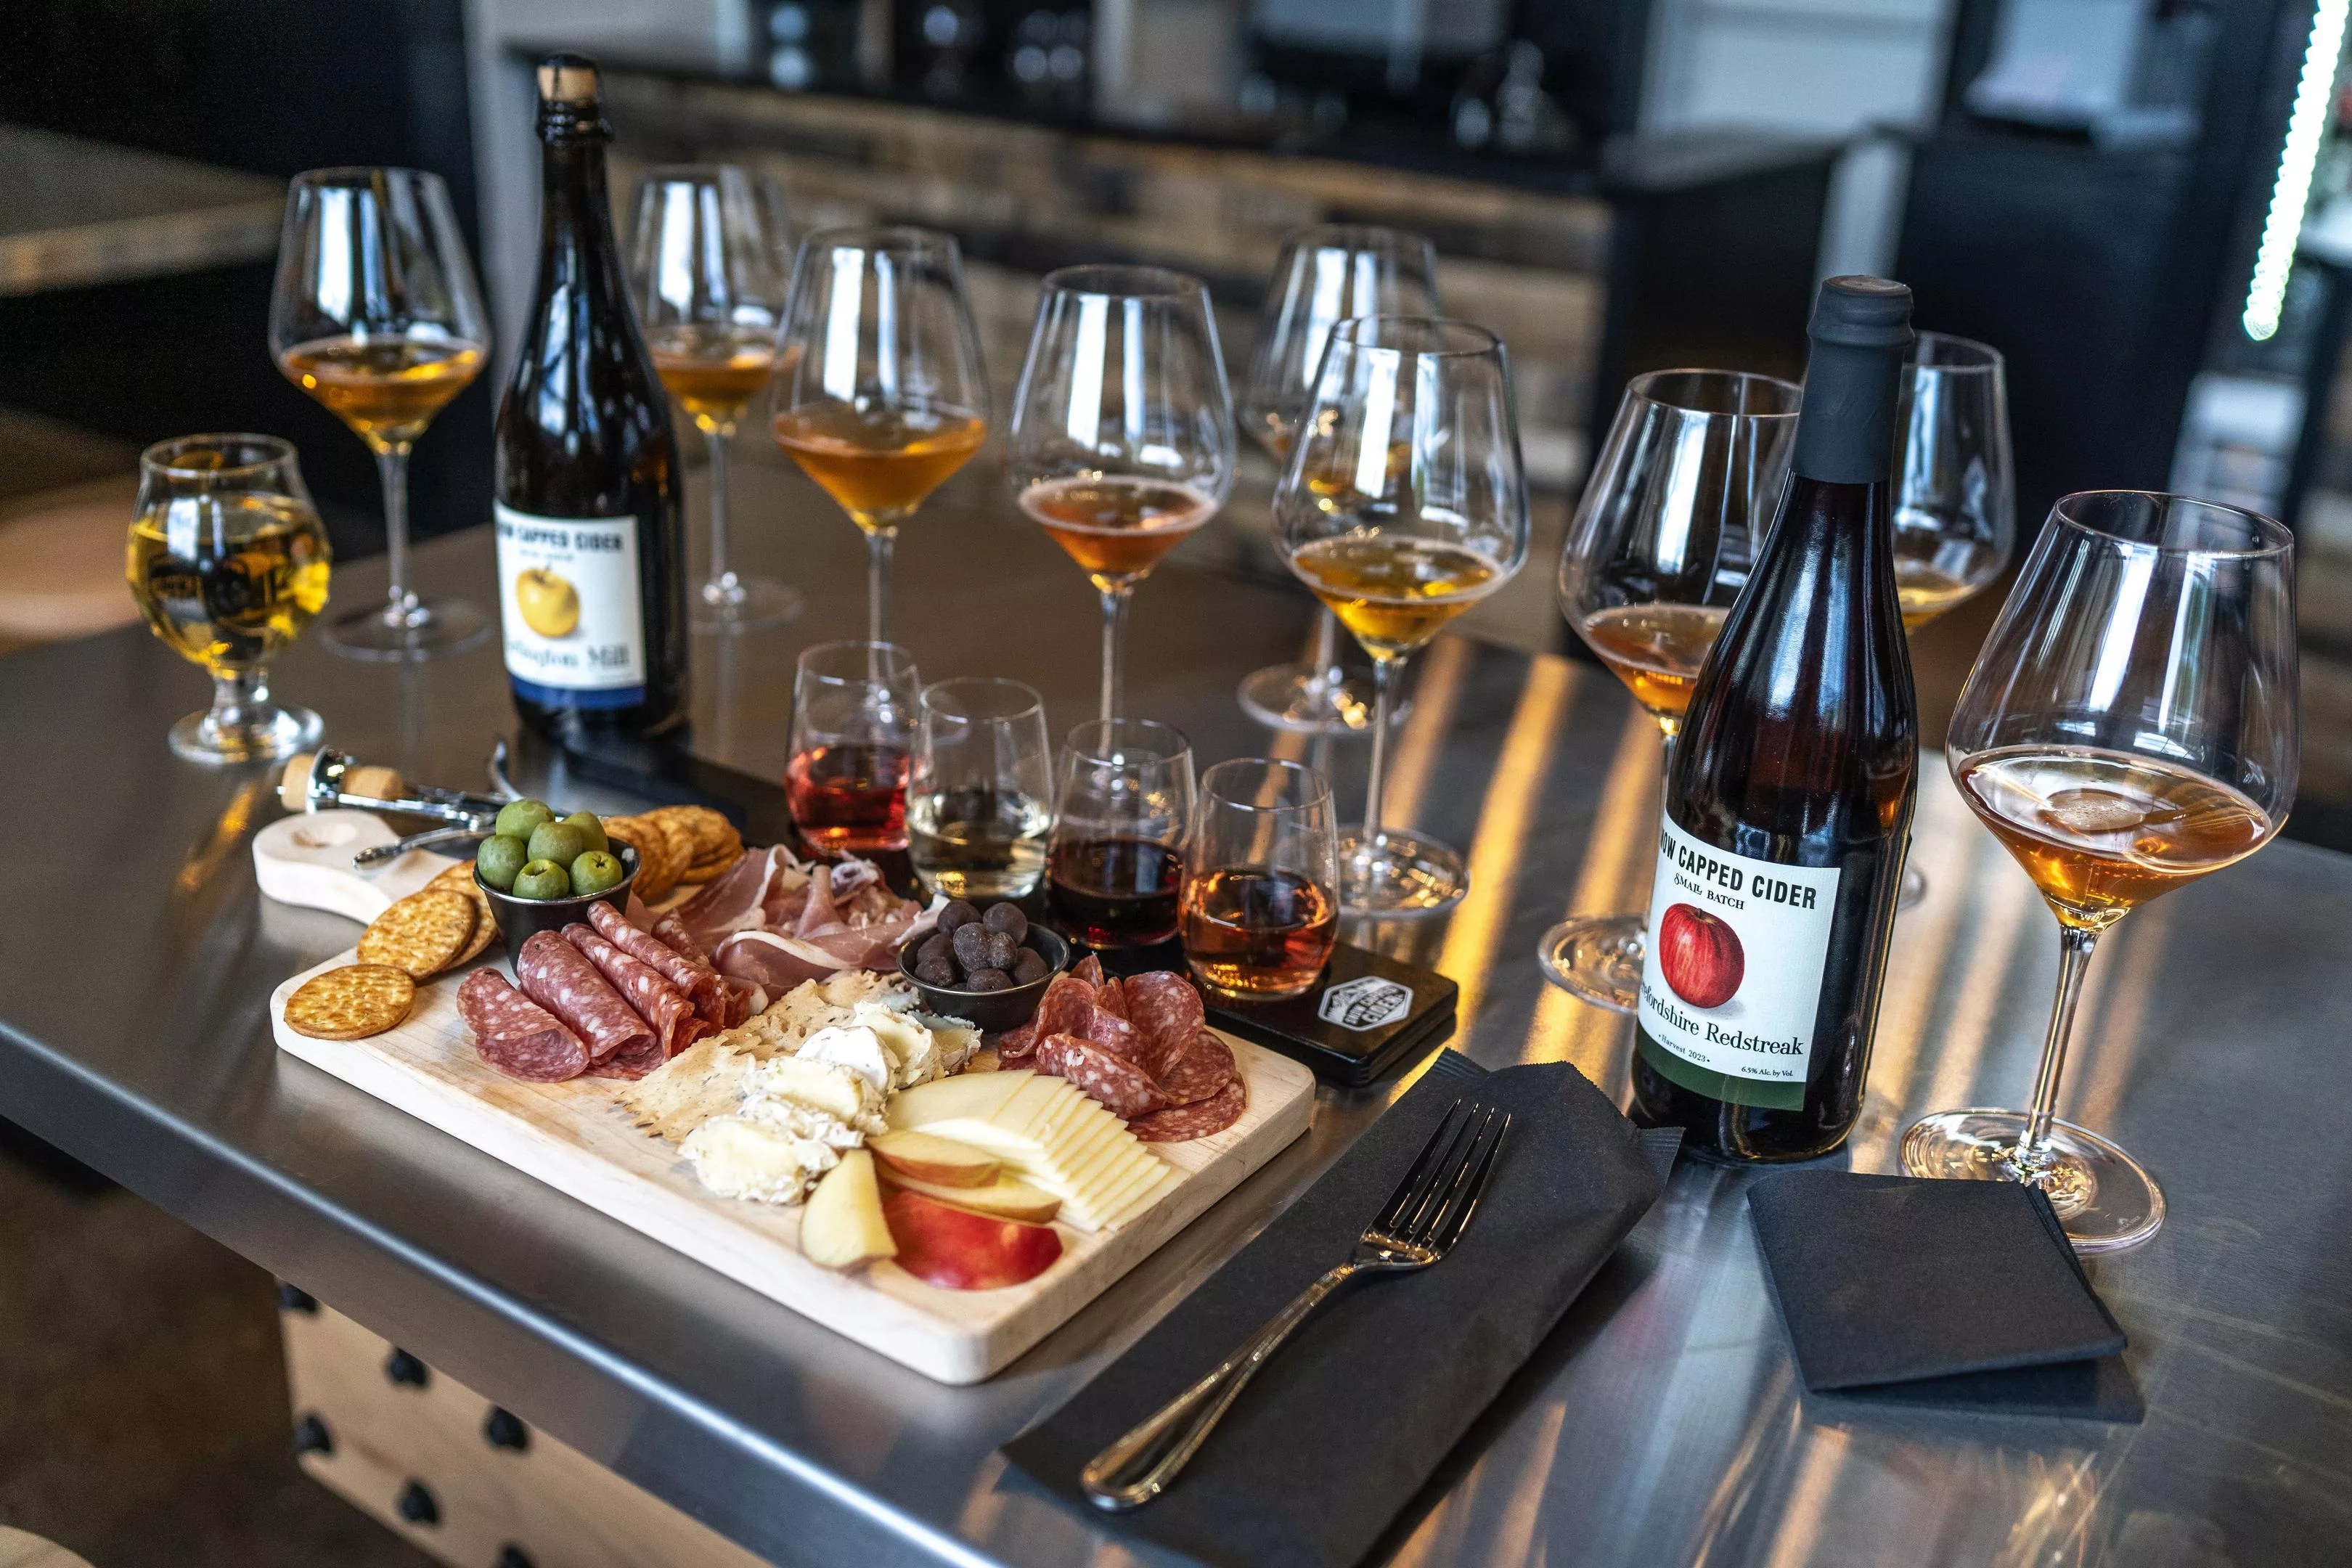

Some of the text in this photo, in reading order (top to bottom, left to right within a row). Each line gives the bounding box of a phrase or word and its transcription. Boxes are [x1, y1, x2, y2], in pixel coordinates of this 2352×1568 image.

[1673, 873, 1744, 910] SMALL BATCH
[1678, 845, 1744, 891] CAPPED
[1752, 875, 1817, 910] CIDER
[1704, 1021, 1804, 1055] Redstreak
[1741, 1066, 1757, 1074] 6.5%
[1773, 1069, 1781, 1078] by
